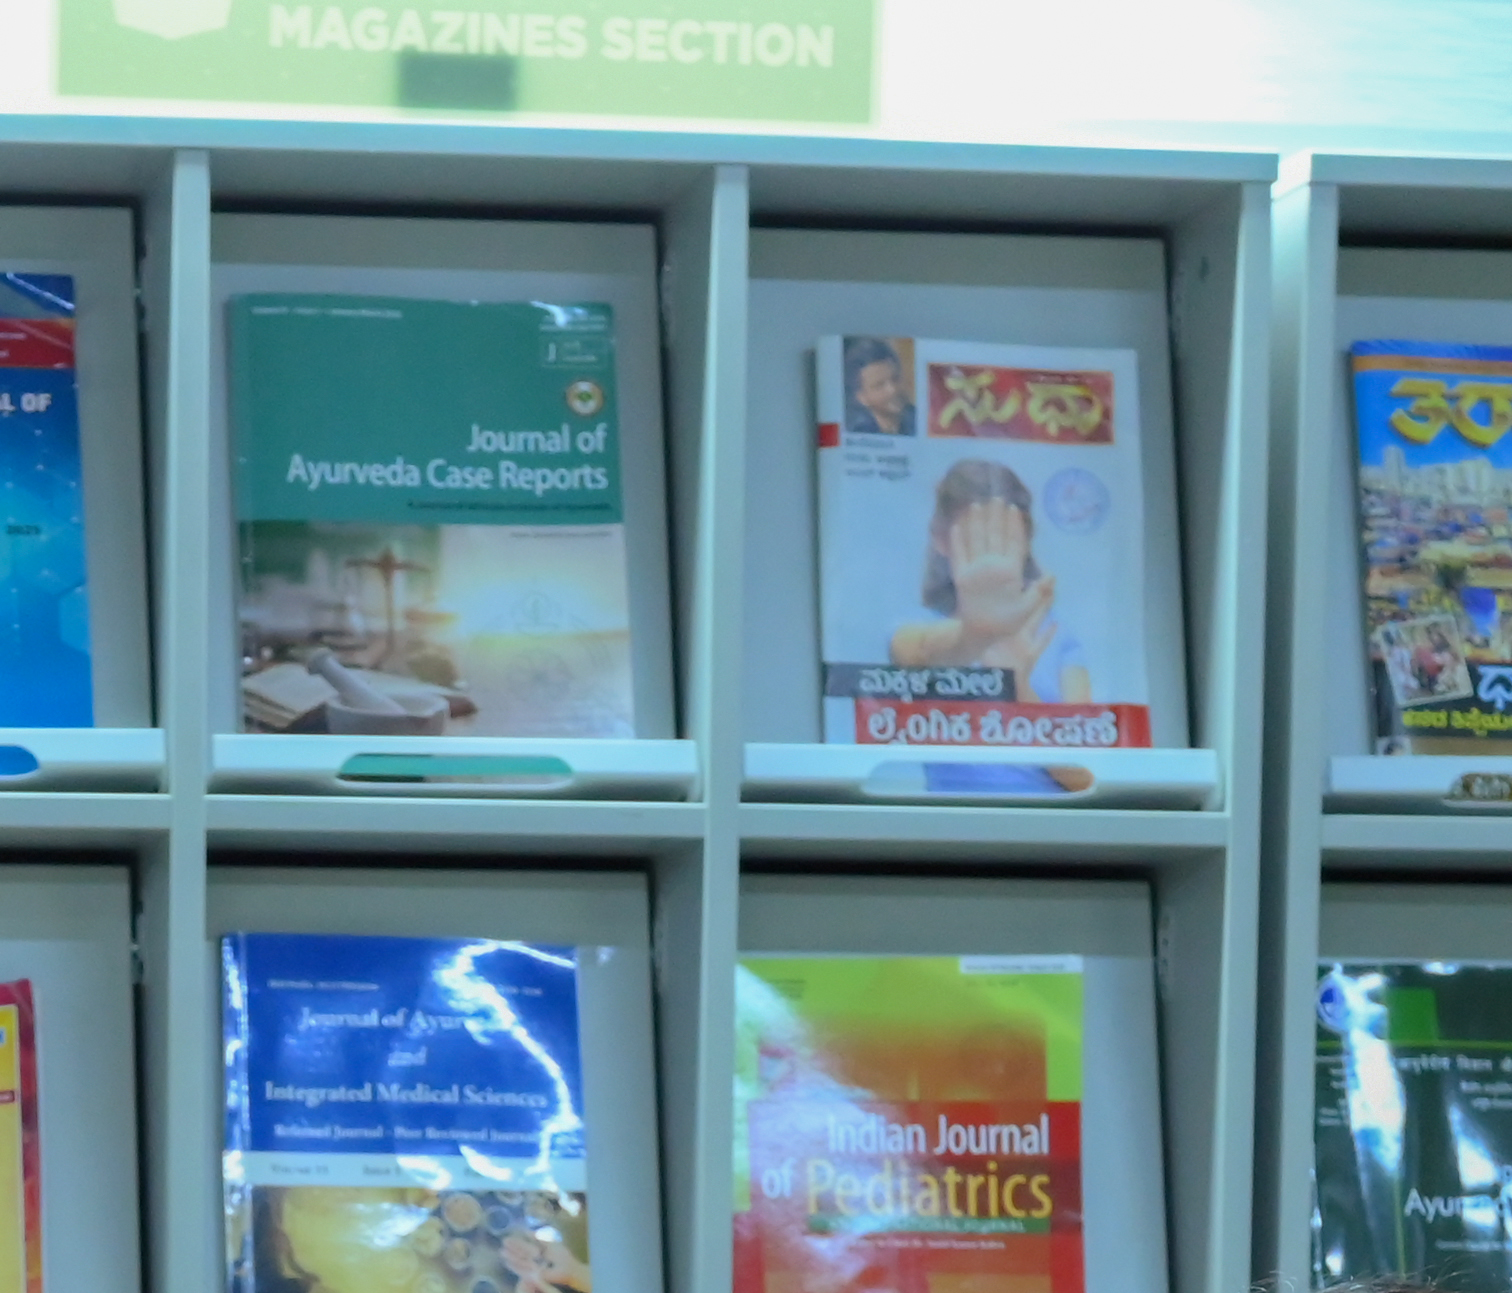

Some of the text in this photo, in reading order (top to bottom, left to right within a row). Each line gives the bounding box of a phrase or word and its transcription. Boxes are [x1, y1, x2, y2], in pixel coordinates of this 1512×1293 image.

[267, 3, 834, 69] MAGAZINES SECTION
[21, 392, 52, 413] OF
[939, 367, 1104, 437] ಸುಧಾ
[467, 423, 607, 453] Journal of
[287, 454, 608, 496] Ayurveda Case Reports
[298, 1007, 407, 1031] Journal of
[388, 1045, 427, 1066] and
[266, 1081, 547, 1108] Integrated Medical Sciences
[828, 1114, 1049, 1156] Indian Journal
[761, 1159, 1054, 1219] of Pediatrics
